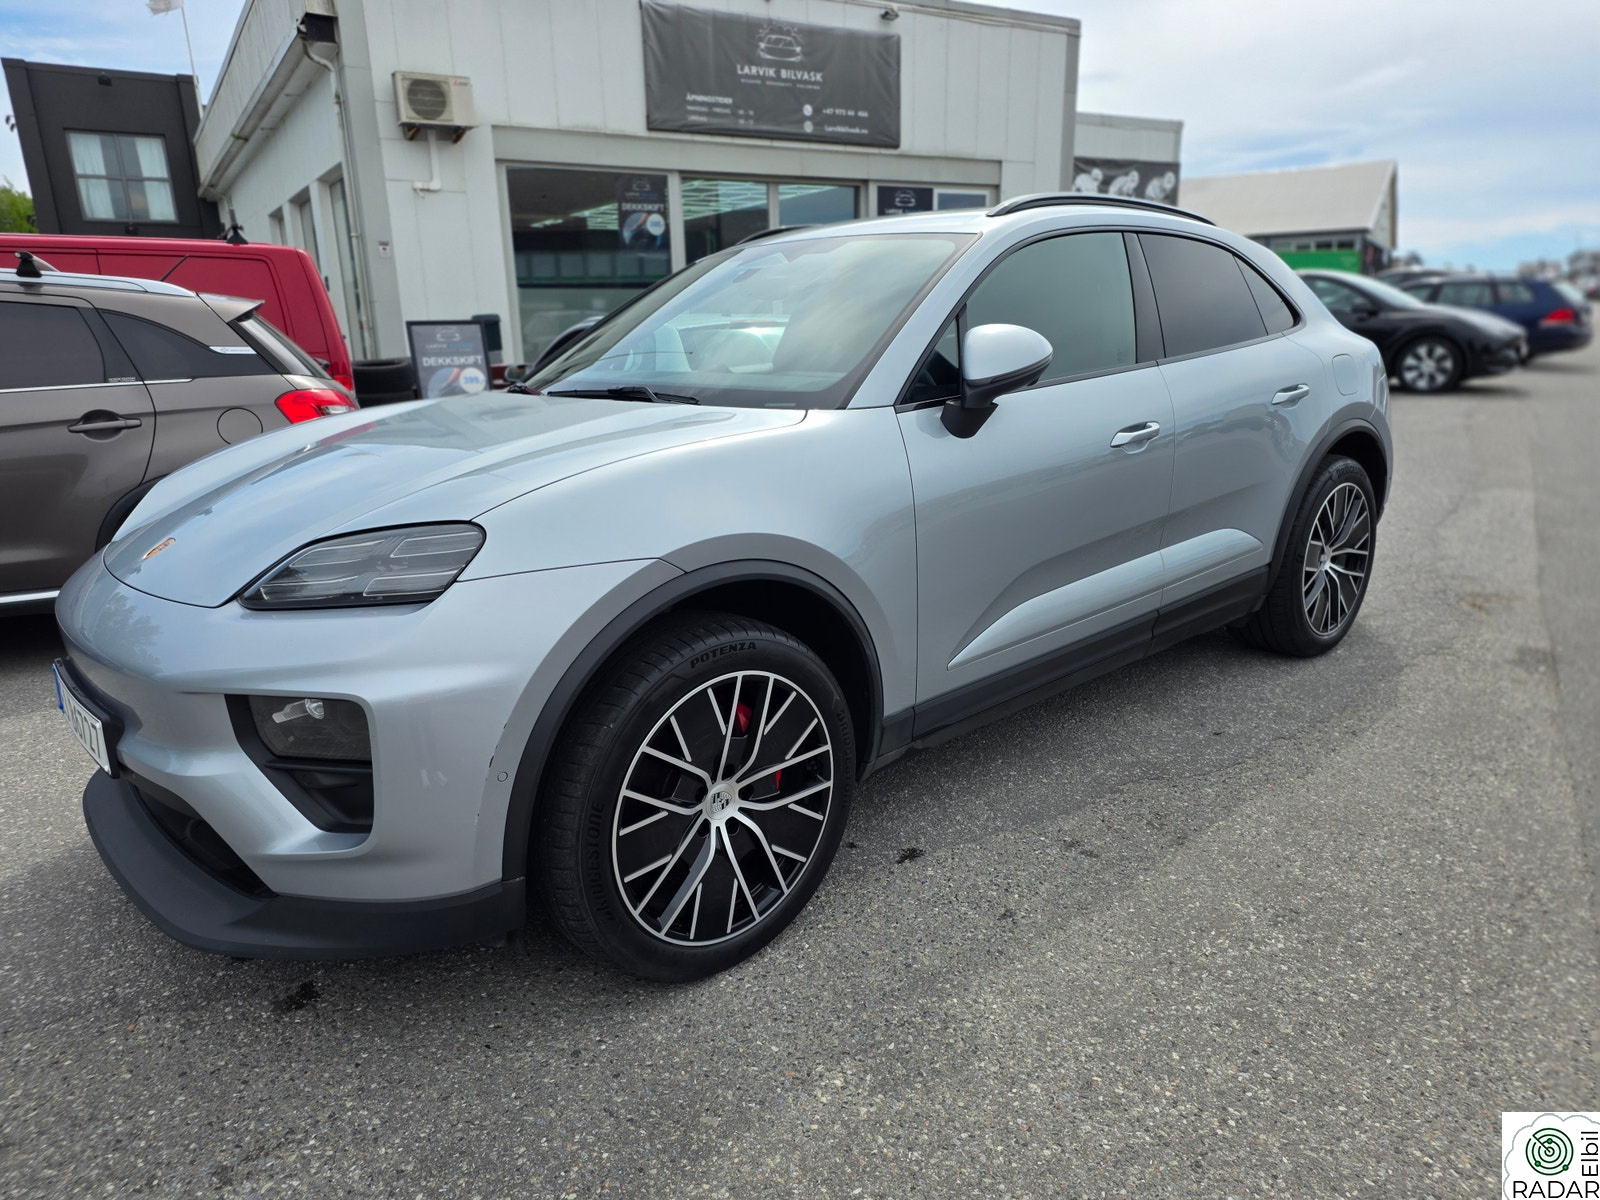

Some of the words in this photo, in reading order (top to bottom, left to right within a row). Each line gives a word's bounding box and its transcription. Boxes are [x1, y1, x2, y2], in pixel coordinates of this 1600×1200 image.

[736, 64, 776, 78] LARVIK
[780, 69, 823, 82] BILVASK
[422, 355, 482, 367] DEKKSKIFT
[690, 641, 757, 669] POTENZA
